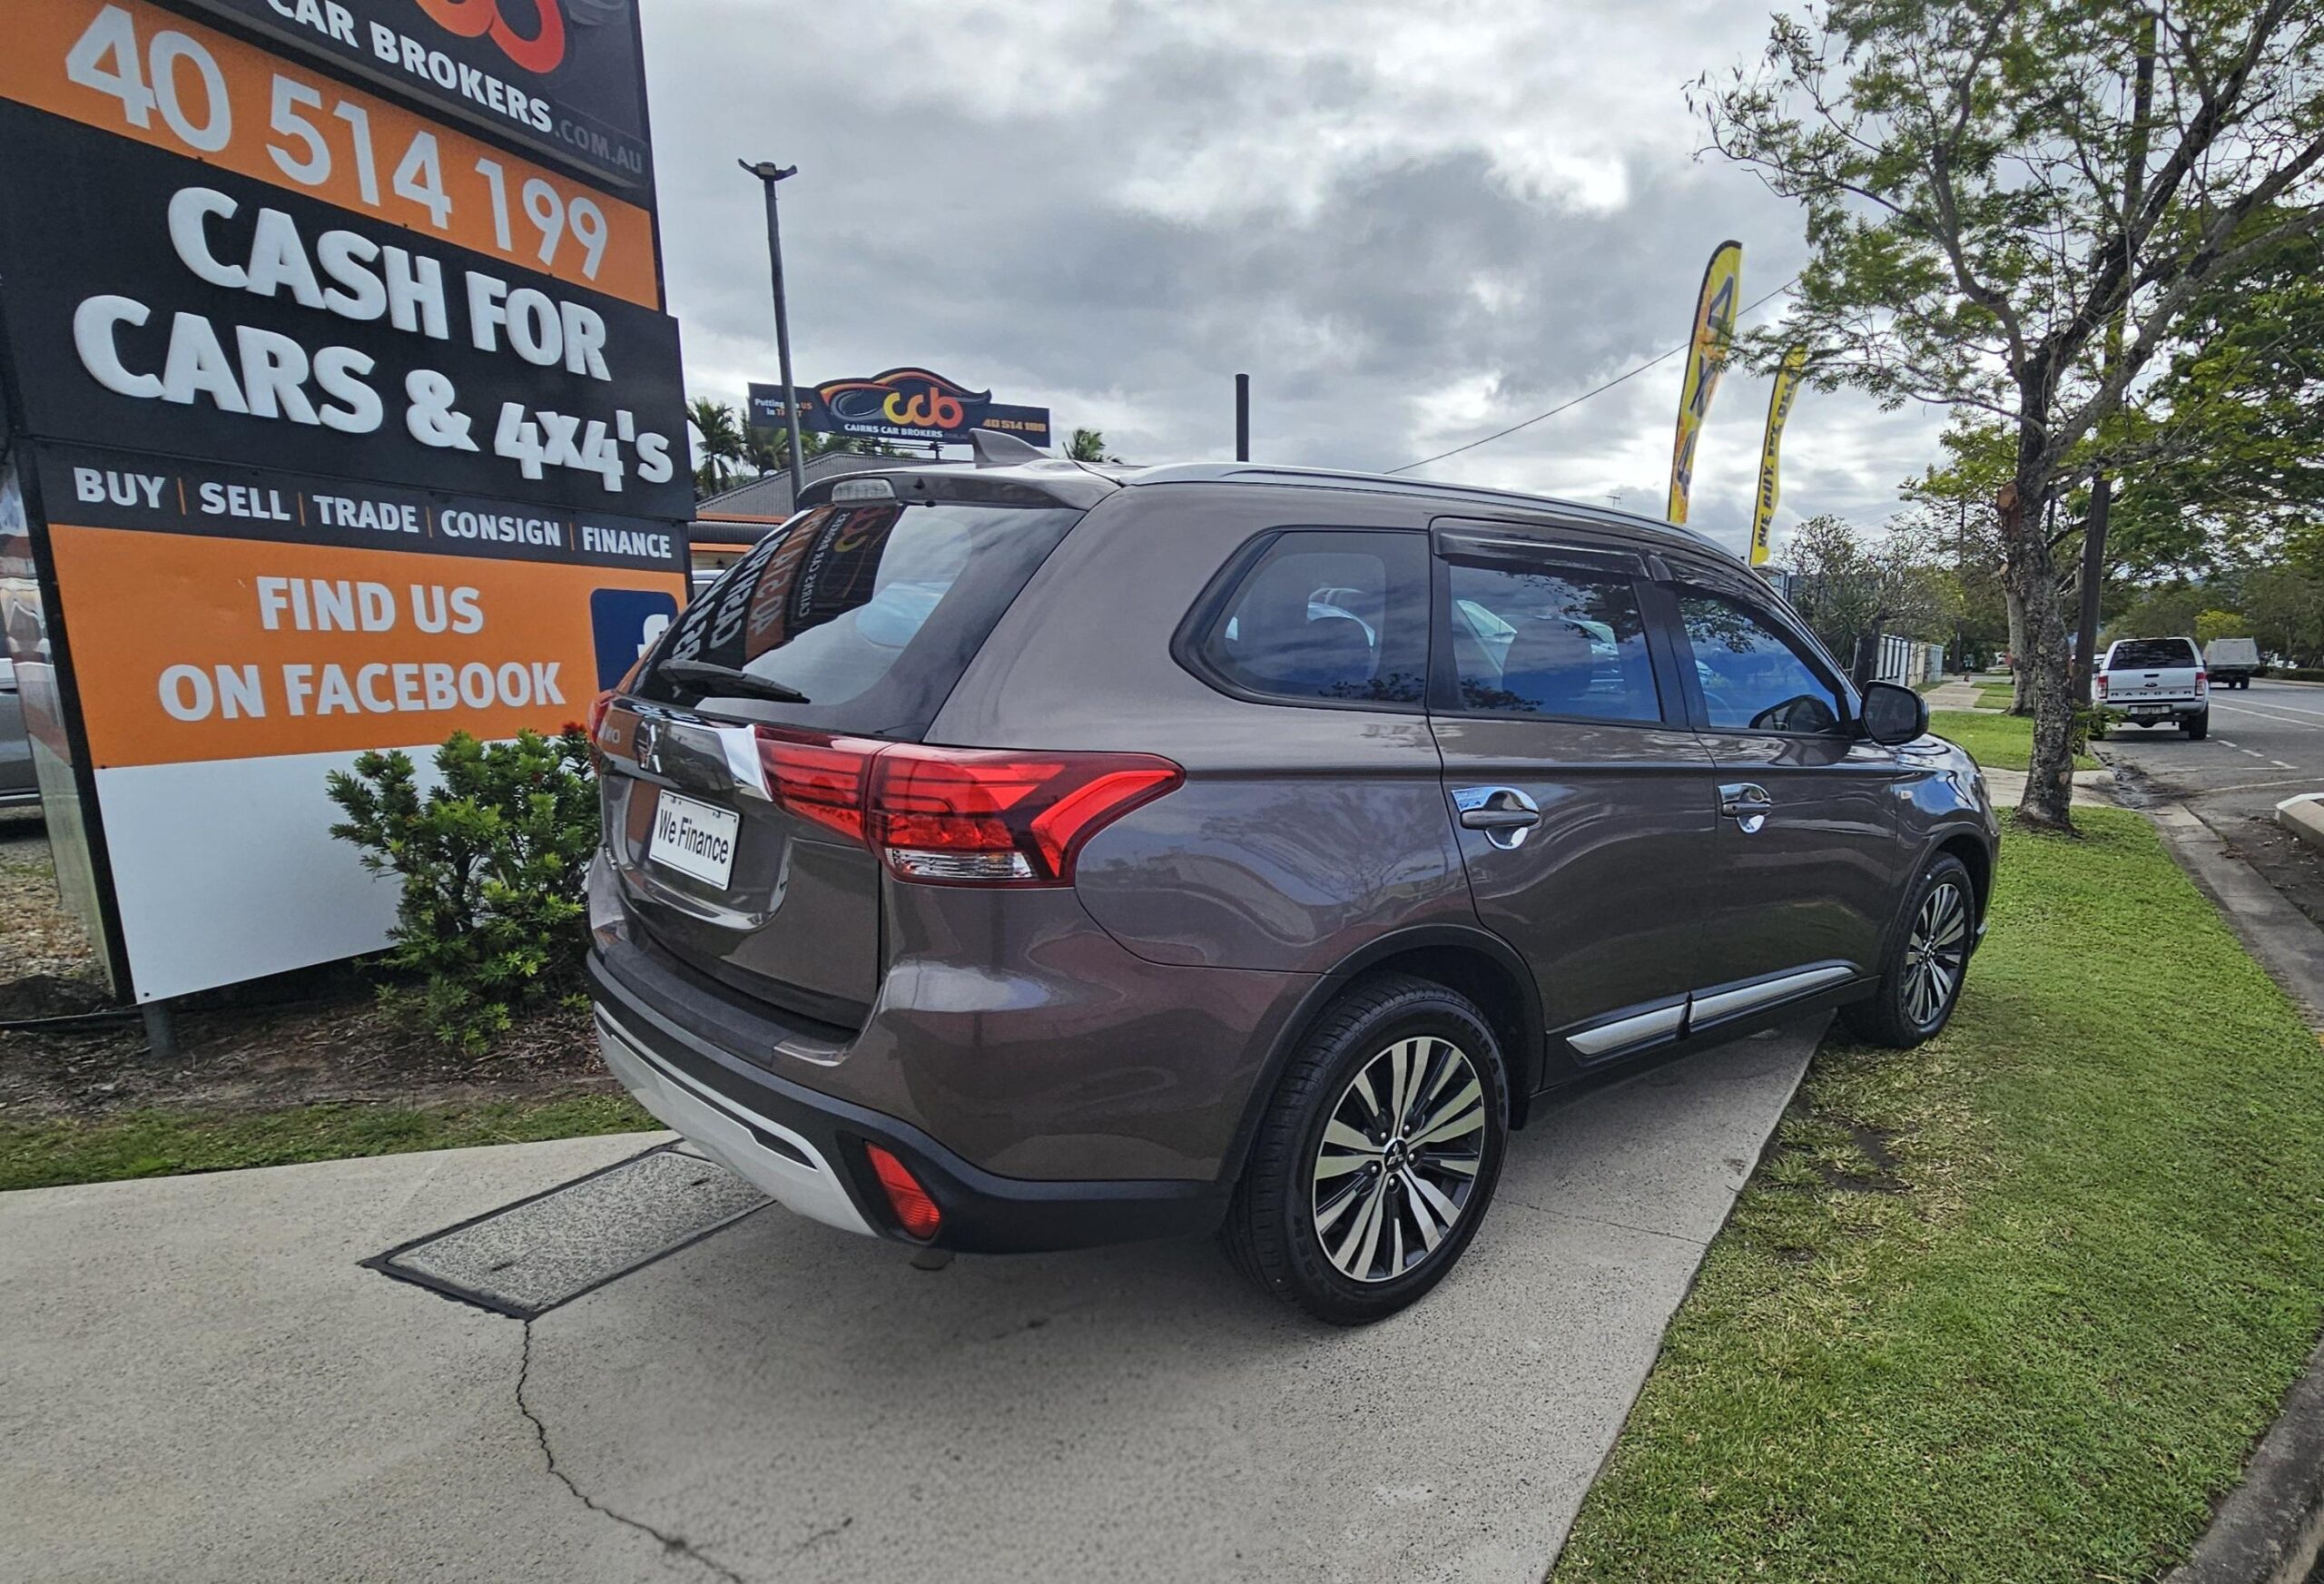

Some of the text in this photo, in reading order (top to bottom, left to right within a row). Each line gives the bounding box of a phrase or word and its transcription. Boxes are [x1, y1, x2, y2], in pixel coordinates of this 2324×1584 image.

[65, 4, 608, 281] 40 514 199
[167, 186, 613, 381] CASH FOR
[74, 294, 383, 434] CARS
[405, 369, 479, 452] &
[844, 423, 879, 433] CAIRNS
[881, 425, 899, 435] CAR
[901, 428, 943, 438] BROKERS
[982, 418, 1000, 428] 40
[1001, 420, 1023, 430] 514
[74, 466, 673, 559] BUY SELL TRADE CONSIGN FINANCE
[1758, 513, 1773, 547] WE
[256, 576, 485, 635] FIND US
[158, 661, 567, 722] ON FACEBOOK
[658, 809, 729, 865] We Finance
